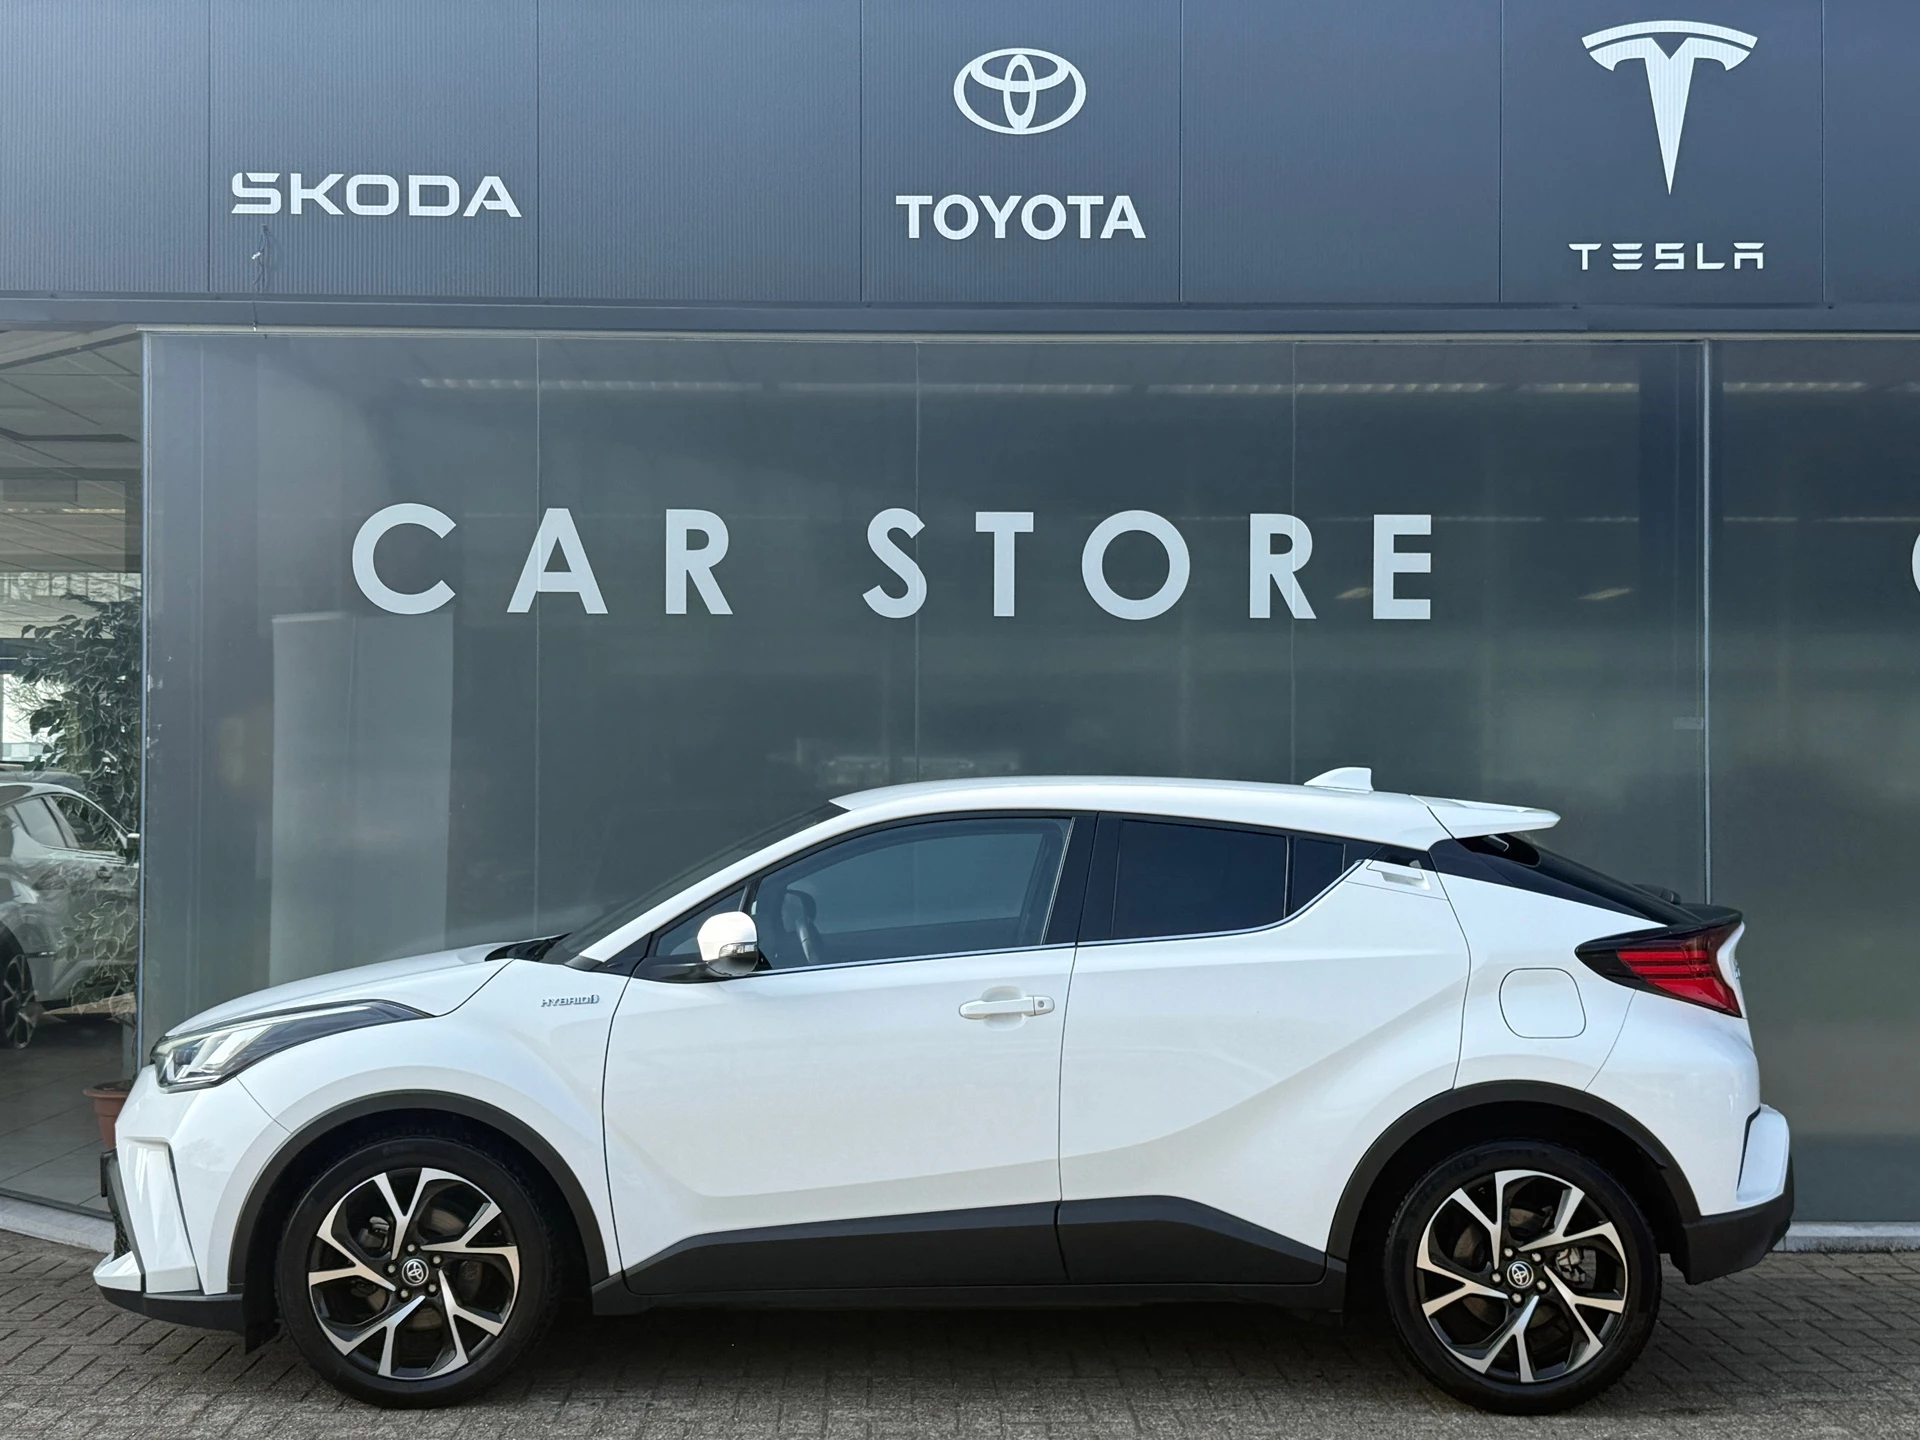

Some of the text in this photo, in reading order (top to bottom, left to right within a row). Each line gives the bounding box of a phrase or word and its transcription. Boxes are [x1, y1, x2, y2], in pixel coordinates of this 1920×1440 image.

[895, 194, 1147, 241] TOYOTA
[1568, 242, 1765, 271] TESLA
[351, 502, 1433, 621] CAR STORE
